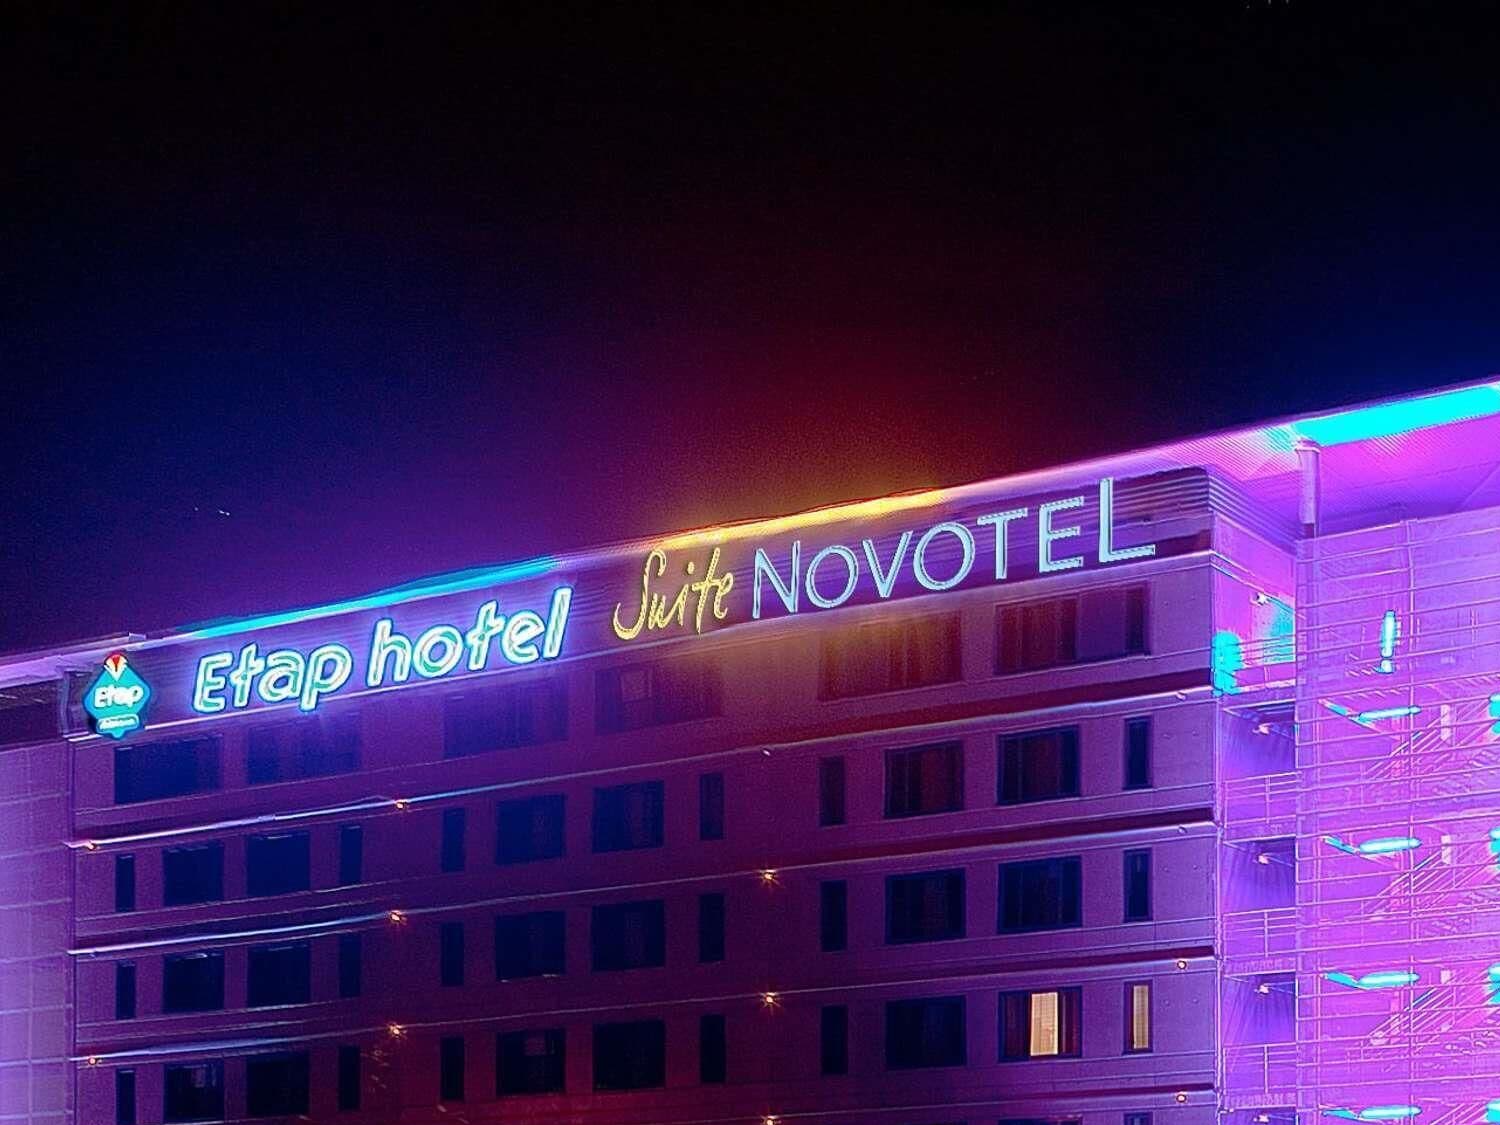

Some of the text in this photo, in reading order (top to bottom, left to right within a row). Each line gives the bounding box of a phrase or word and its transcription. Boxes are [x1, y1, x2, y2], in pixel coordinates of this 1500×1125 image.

[613, 477, 1156, 640] Suite NOVOTEL
[194, 587, 573, 713] Etap hotel
